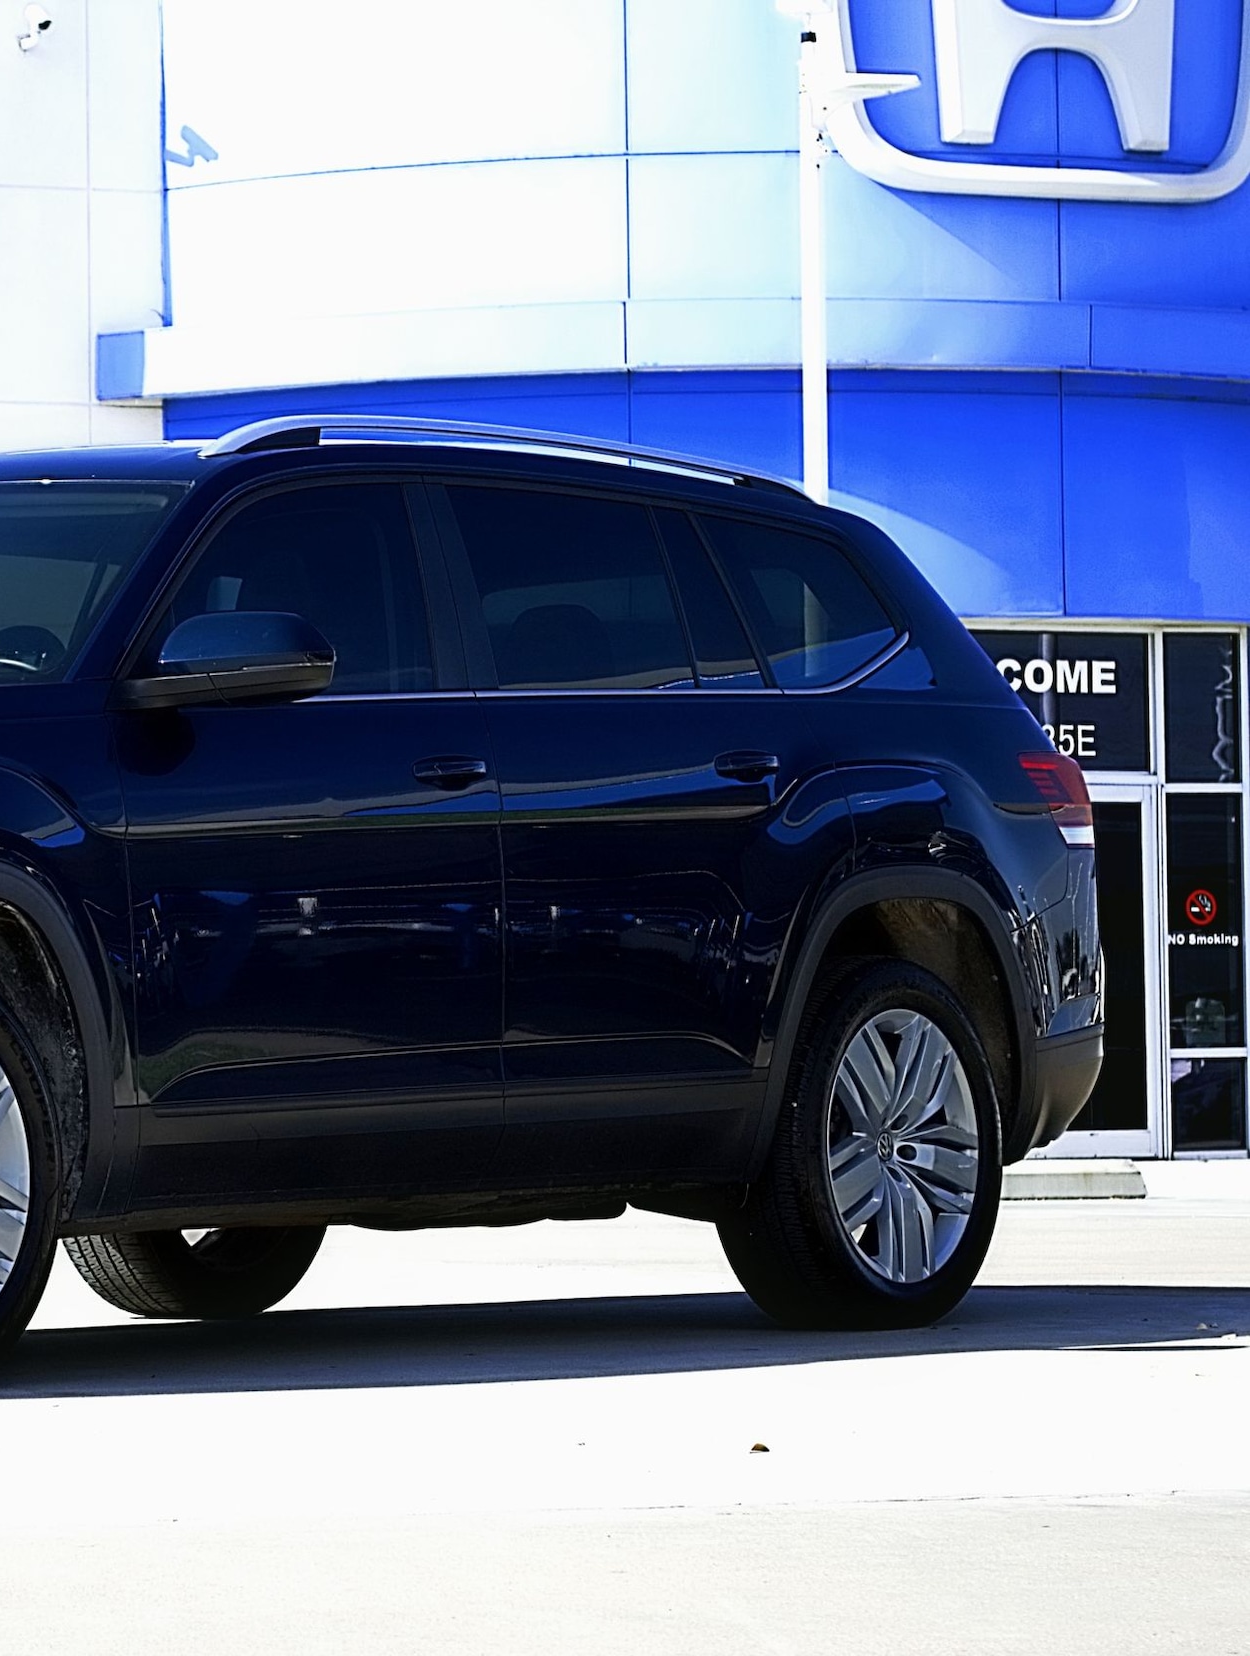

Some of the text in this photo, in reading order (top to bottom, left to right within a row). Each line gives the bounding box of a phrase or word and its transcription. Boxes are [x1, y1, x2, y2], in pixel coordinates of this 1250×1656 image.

[1167, 933, 1239, 947] NO Smoking
[10, 1039, 56, 1163] COOPER
